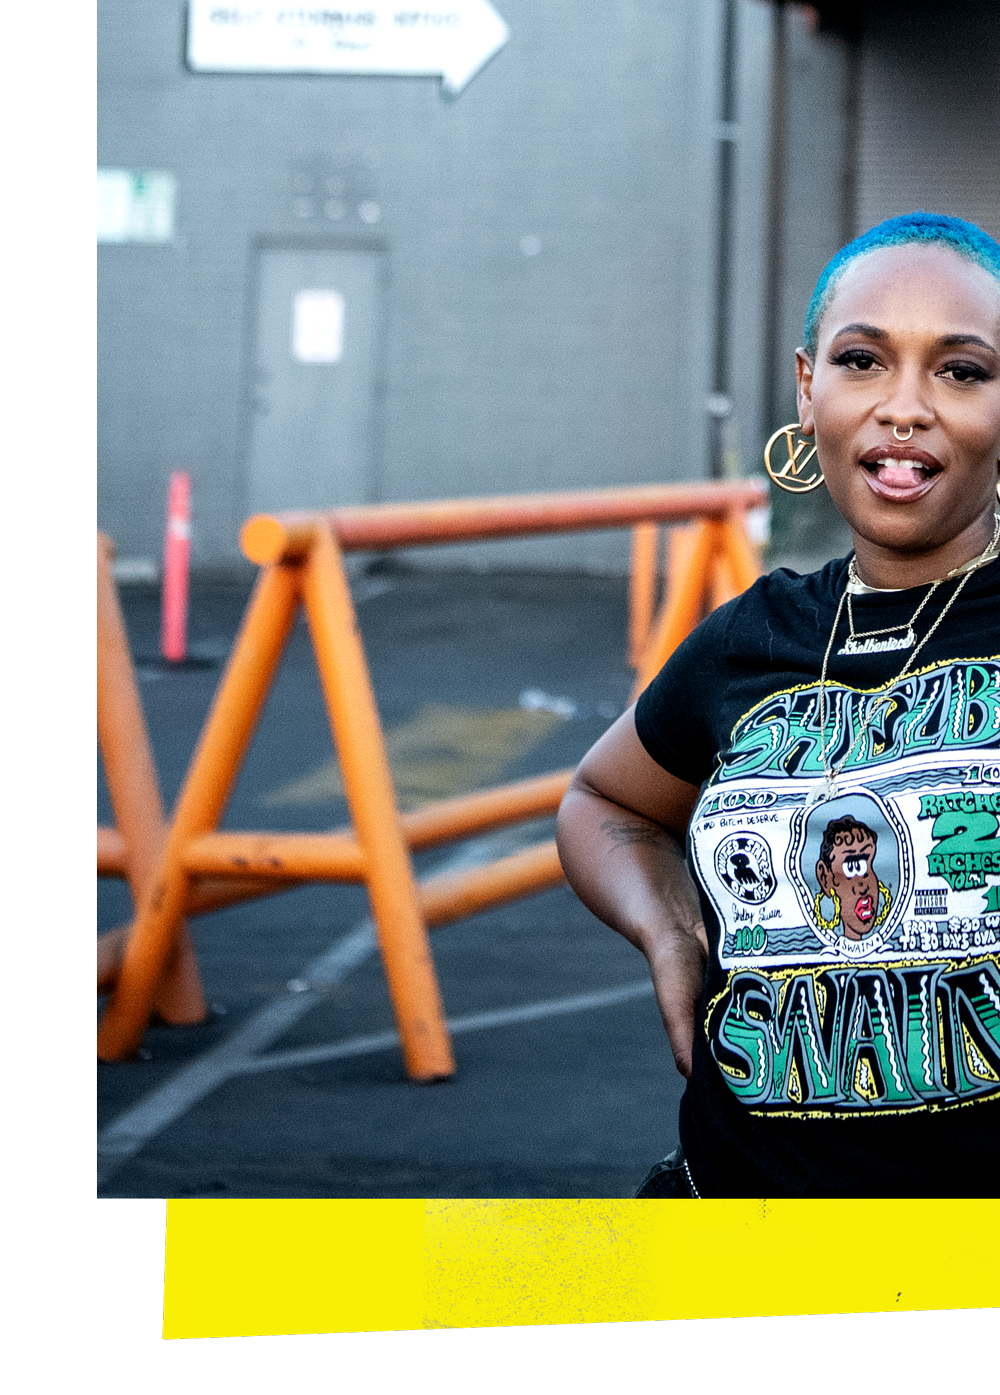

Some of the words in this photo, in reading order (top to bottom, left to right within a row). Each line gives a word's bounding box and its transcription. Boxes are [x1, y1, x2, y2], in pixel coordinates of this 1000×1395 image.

[703, 791, 778, 817] 100
[717, 839, 740, 875] UNITED
[744, 839, 770, 880] STATES
[730, 880, 747, 899] OF
[902, 920, 938, 936] FROM
[948, 916, 981, 933] $30
[734, 924, 767, 955] 100
[841, 940, 875, 954] SWAIN
[899, 934, 917, 951] TO
[920, 932, 939, 952] 30
[942, 931, 970, 950] DAYS
[974, 928, 998, 946] OVA
